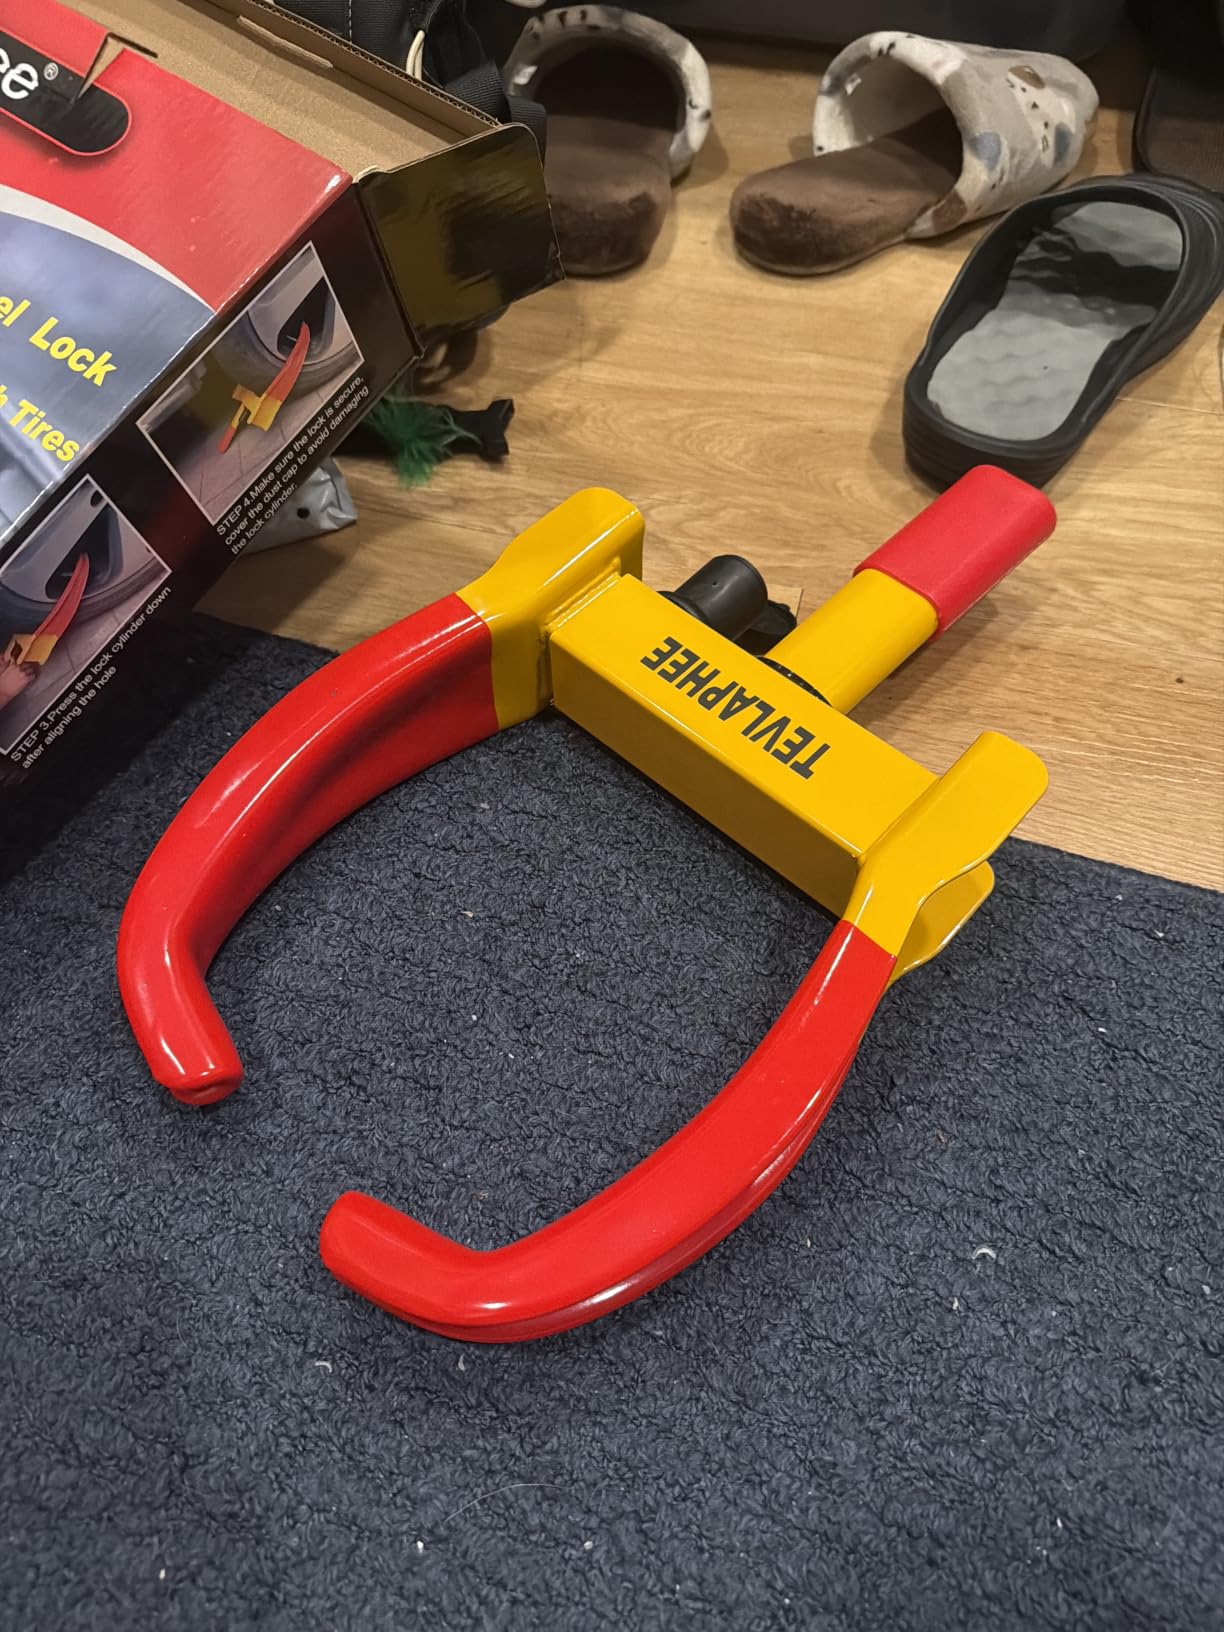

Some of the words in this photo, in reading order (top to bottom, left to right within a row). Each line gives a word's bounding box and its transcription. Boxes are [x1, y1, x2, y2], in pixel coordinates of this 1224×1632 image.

[29, 316, 117, 386] Lock
[8, 399, 80, 462] Tires
[217, 505, 242, 535] STEP
[275, 451, 294, 473] sure
[293, 435, 308, 452] the
[307, 416, 326, 436] lock
[325, 407, 334, 418] is
[225, 517, 248, 545] cover
[248, 503, 263, 519] the
[263, 481, 283, 503] dust
[282, 464, 298, 483] cap
[297, 453, 308, 465] to
[307, 427, 330, 455] avoid
[329, 386, 369, 430] damaging
[231, 538, 247, 555] the
[245, 518, 264, 539] lock
[264, 483, 297, 519] cylinder.
[11, 730, 39, 761] STEP
[75, 674, 93, 691] the
[90, 653, 112, 675] lock
[111, 613, 146, 653] cylinder
[146, 587, 171, 615] down
[22, 744, 44, 769] after
[44, 706, 82, 745] aligning
[78, 689, 96, 706] the
[94, 666, 117, 689] hole
[640, 636, 831, 780] TEVLAPHEE
